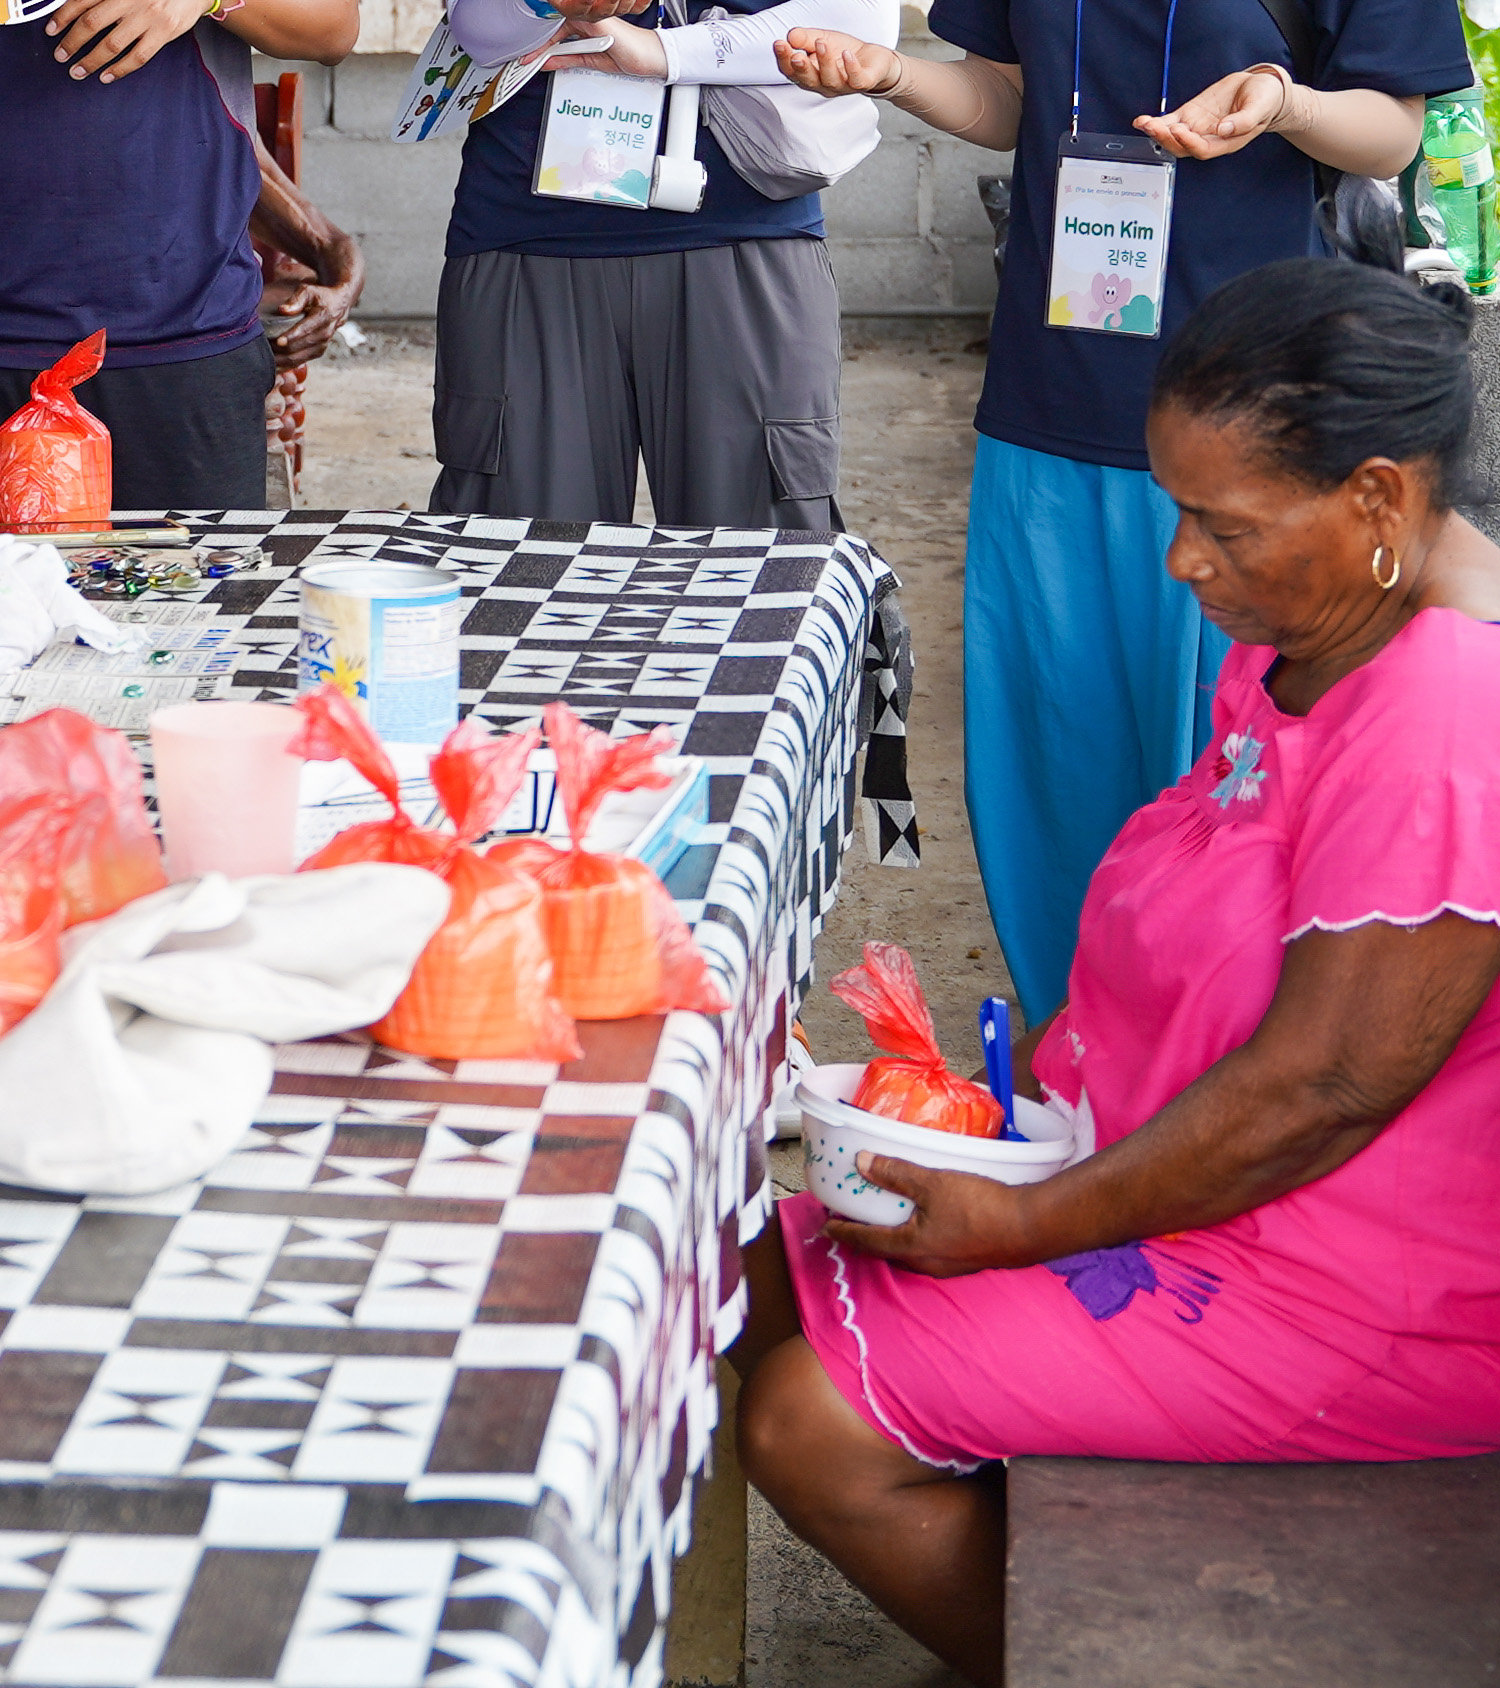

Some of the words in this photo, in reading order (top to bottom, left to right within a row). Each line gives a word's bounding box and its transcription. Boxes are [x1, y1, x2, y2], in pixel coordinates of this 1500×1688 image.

[556, 98, 604, 120] Jieun
[608, 105, 654, 129] Jung
[603, 129, 645, 150] 정지은
[1064, 215, 1115, 238] Haon
[1120, 219, 1154, 240] Kim
[1107, 249, 1148, 269] 김하온
